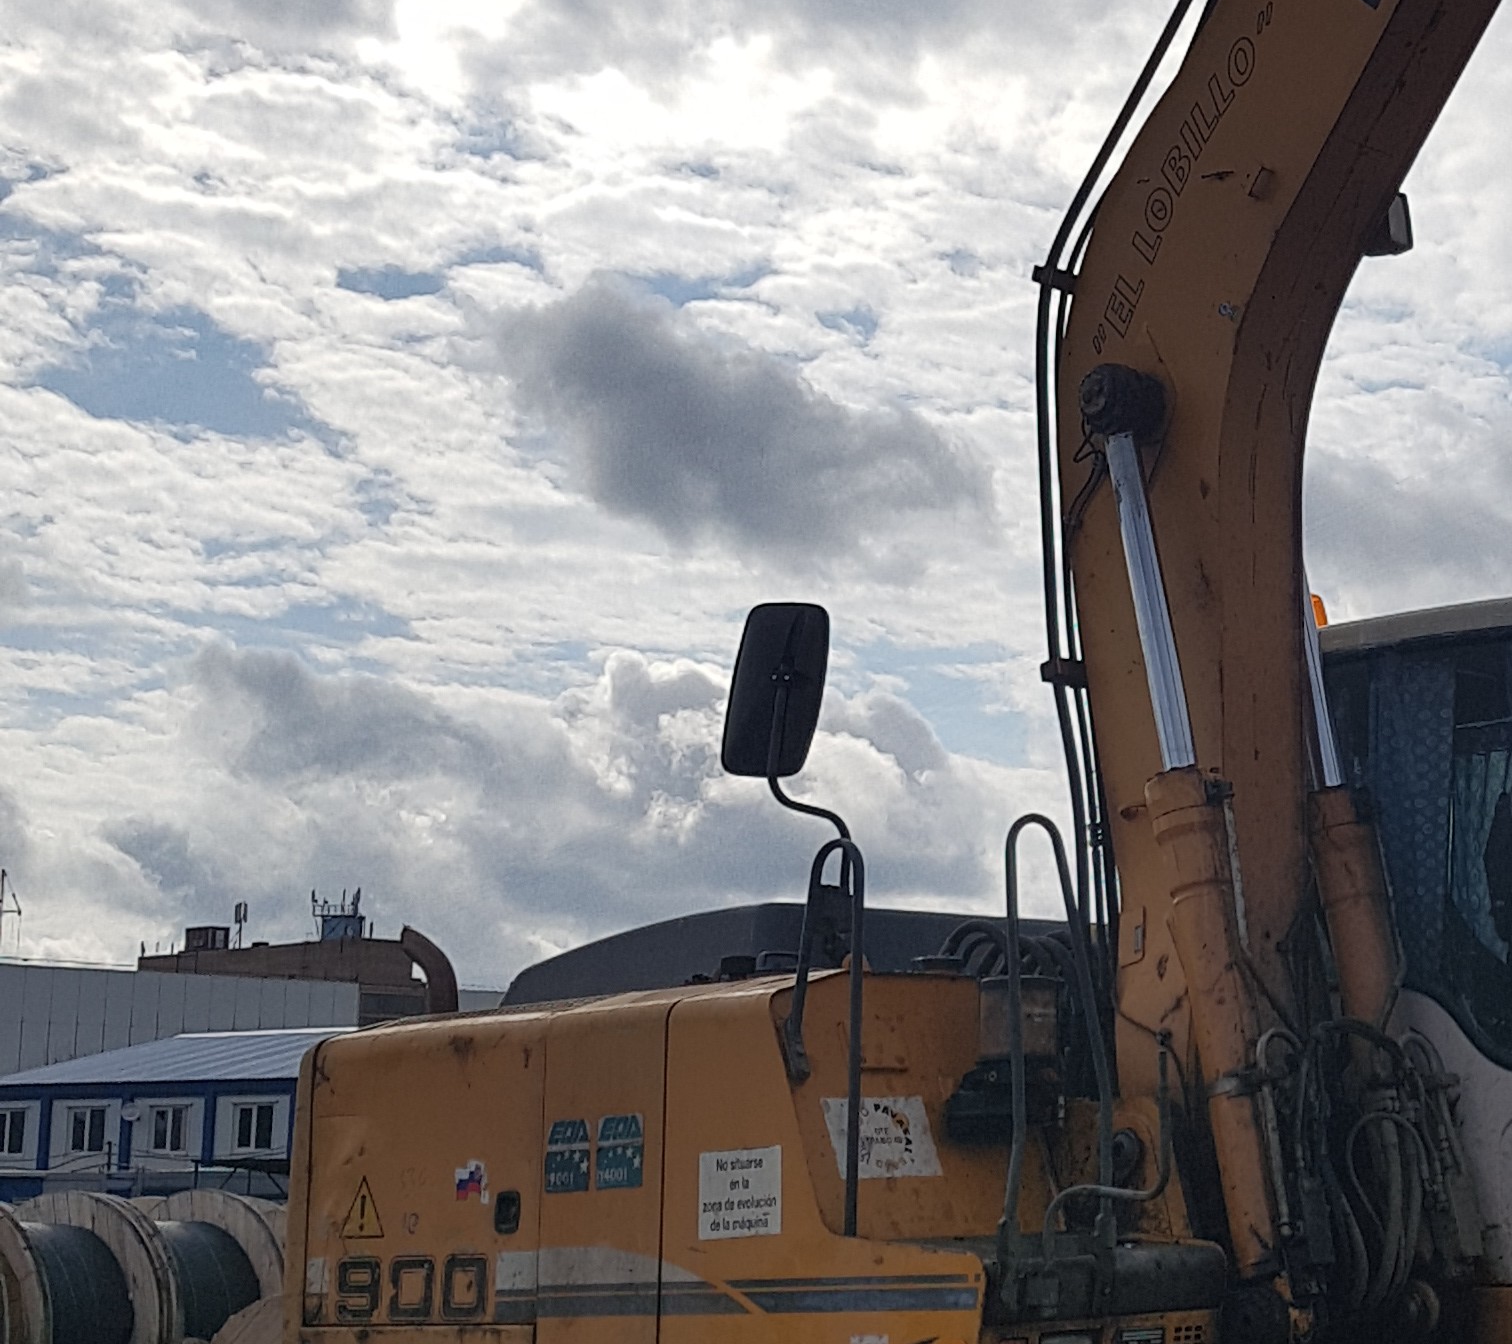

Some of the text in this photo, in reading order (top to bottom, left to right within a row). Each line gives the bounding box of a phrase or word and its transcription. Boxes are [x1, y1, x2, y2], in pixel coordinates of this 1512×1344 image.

[716, 1157, 763, 1172] No situarse
[729, 1176, 750, 1191] en la
[703, 1201, 722, 1213] zona
[724, 1197, 735, 1211] de
[710, 1218, 721, 1232] de
[722, 1217, 730, 1231] la
[336, 1254, 489, 1322] 900
